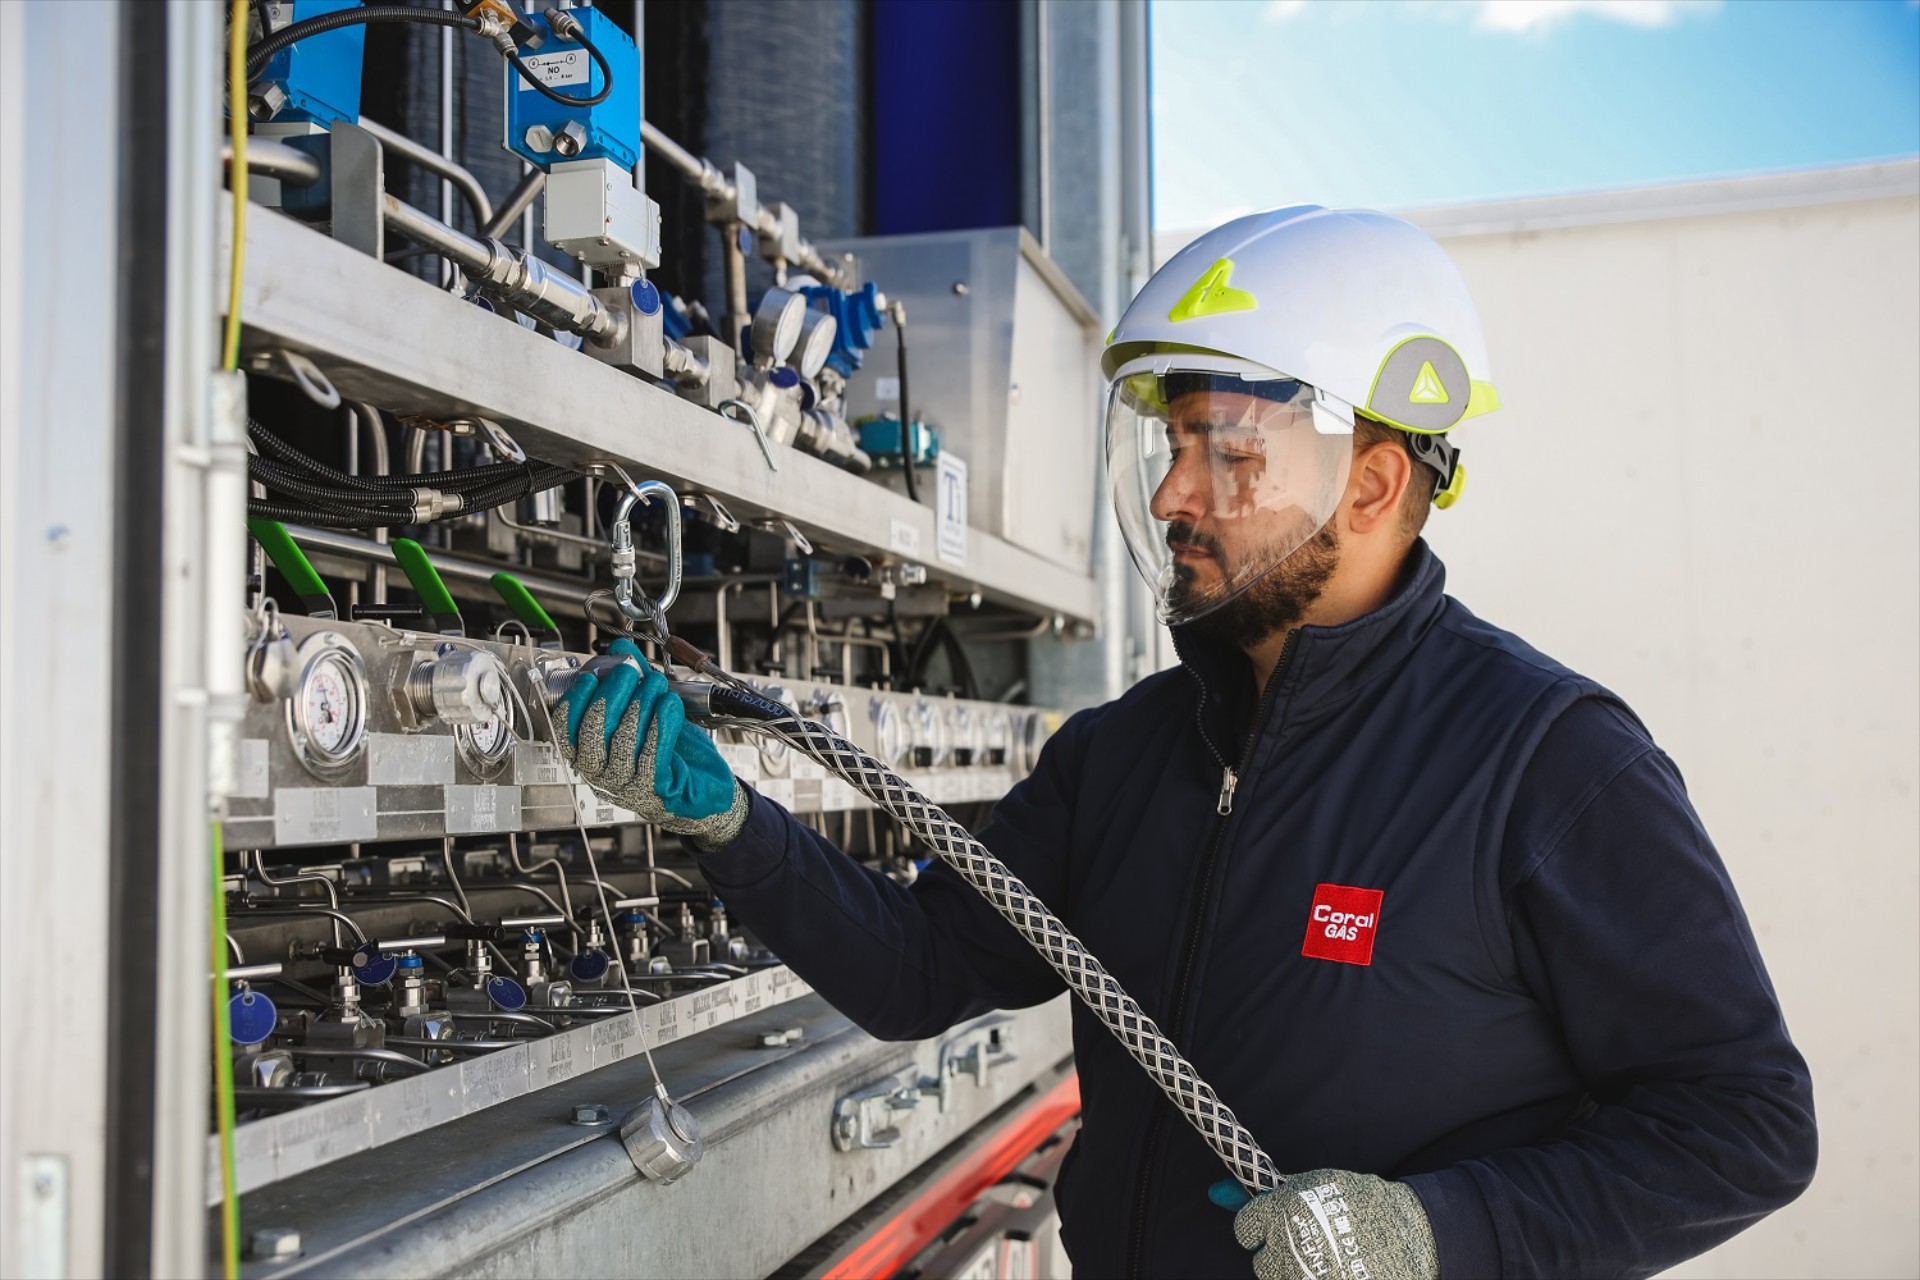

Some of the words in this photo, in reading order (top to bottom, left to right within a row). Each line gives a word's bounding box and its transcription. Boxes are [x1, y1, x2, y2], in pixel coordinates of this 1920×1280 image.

[547, 66, 560, 74] NO
[1313, 904, 1374, 928] Coral
[1324, 923, 1358, 941] GAS
